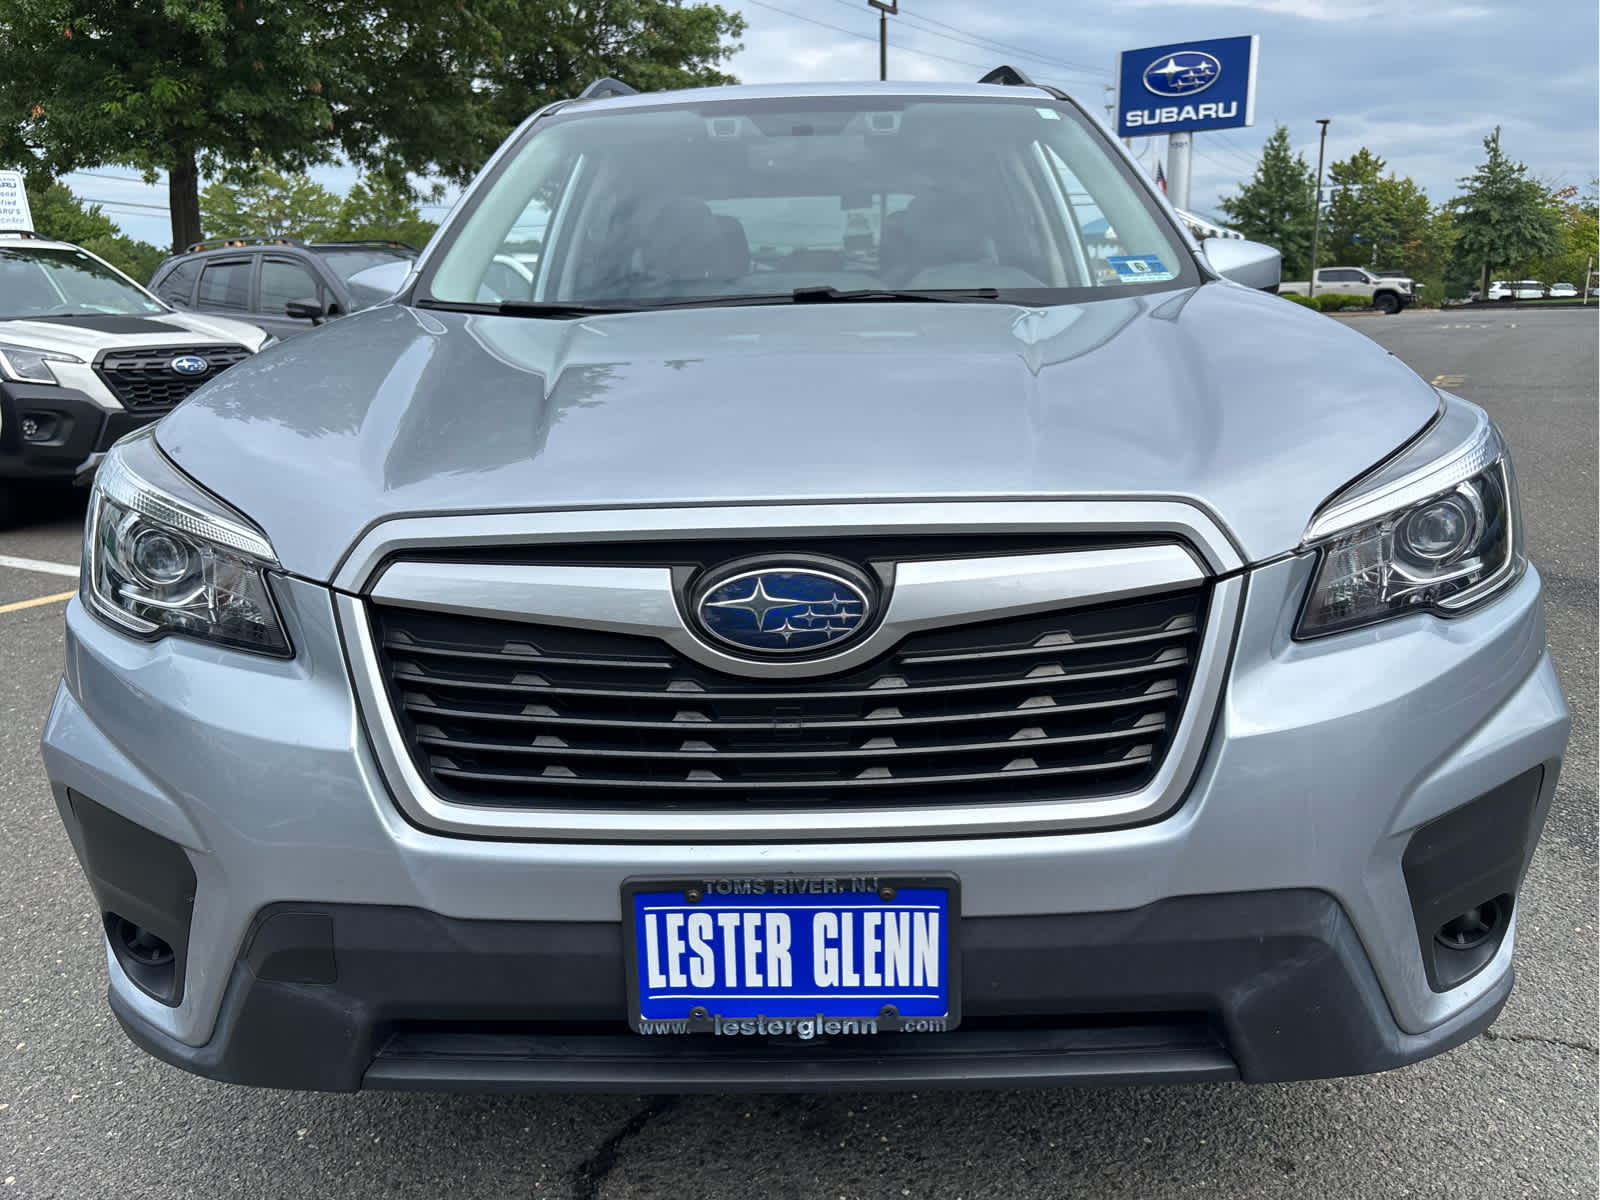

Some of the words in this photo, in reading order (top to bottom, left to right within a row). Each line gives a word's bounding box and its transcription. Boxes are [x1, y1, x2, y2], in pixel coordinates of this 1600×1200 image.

[1125, 101, 1238, 127] SUBARU
[702, 879, 766, 895] TOMS
[773, 878, 844, 895] RIVER,
[851, 876, 879, 893] NJ
[644, 912, 793, 989] LESTER
[812, 911, 940, 988] GLENN
[714, 1013, 879, 1040] lesterglenn
